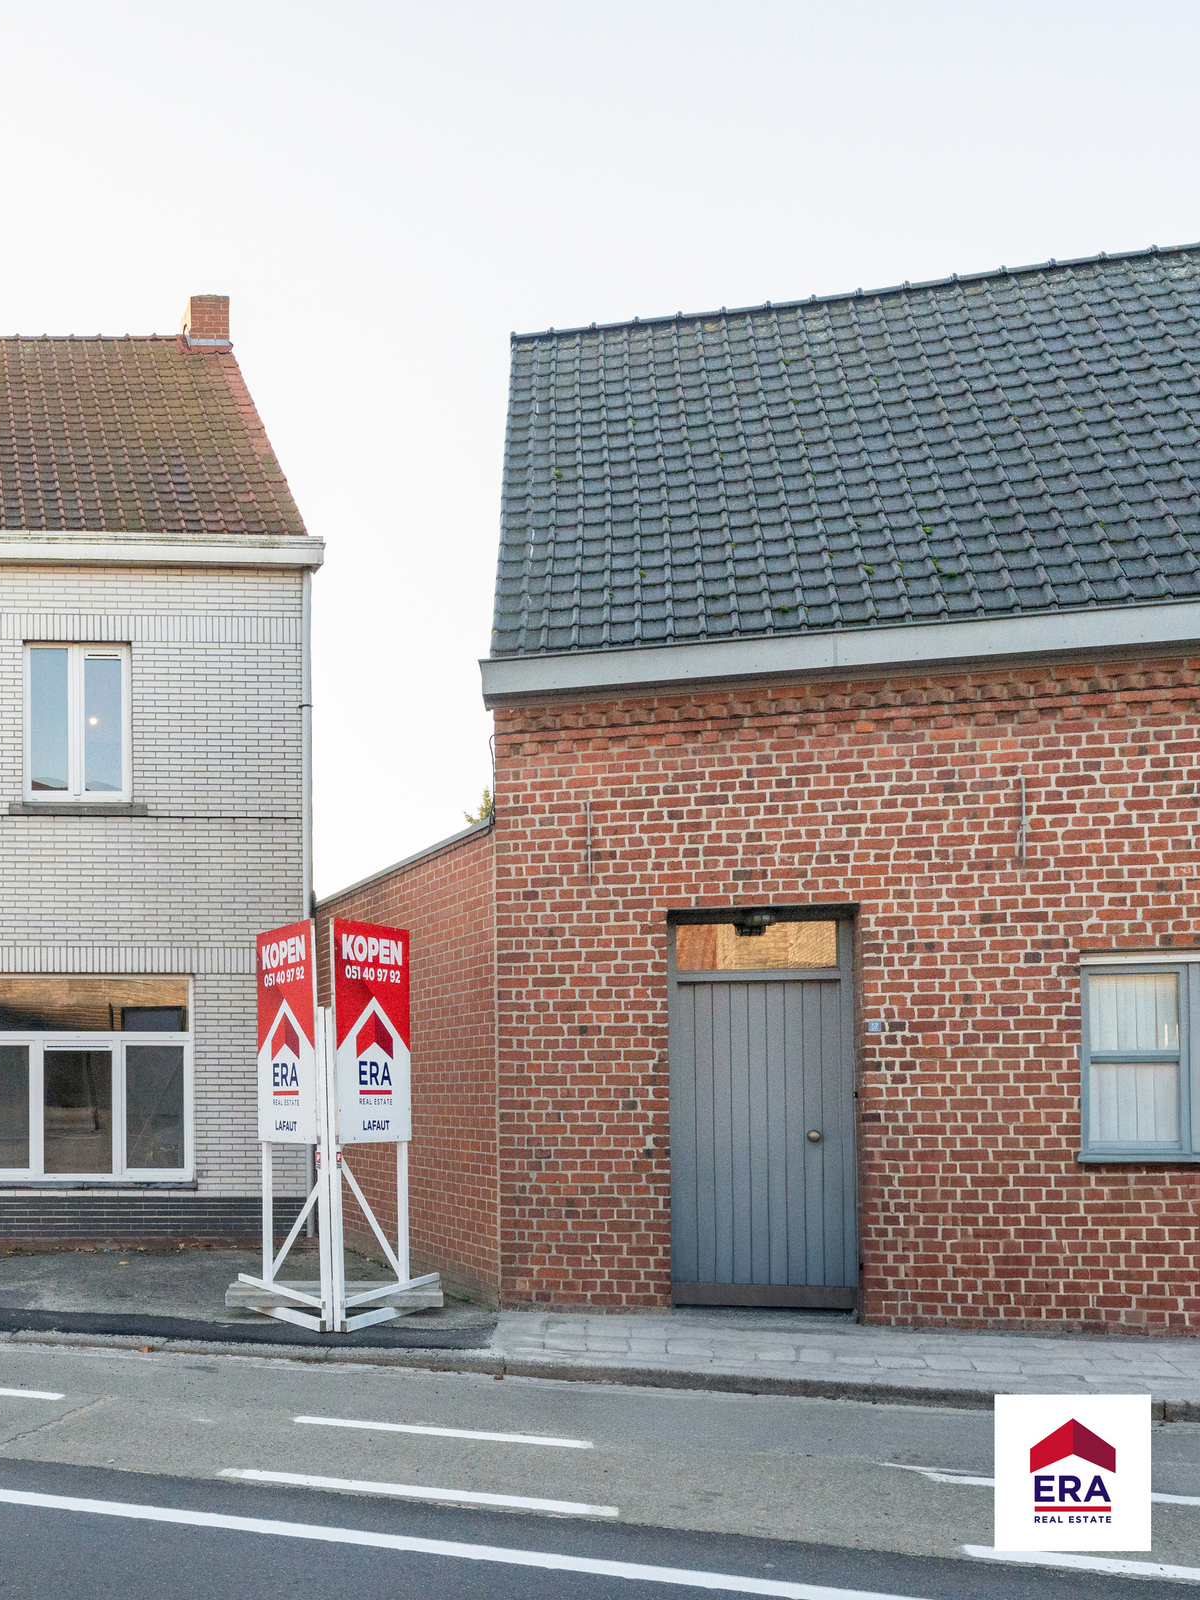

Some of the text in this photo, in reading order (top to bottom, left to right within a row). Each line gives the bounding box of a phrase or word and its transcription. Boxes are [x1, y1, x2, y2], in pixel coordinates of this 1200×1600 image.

[262, 934, 306, 970] KOPEN
[342, 933, 403, 966] KOPEN
[264, 966, 304, 987] 051 40 97 92
[345, 965, 401, 983] 051 40 97 92
[273, 1062, 299, 1087] ERA
[359, 1060, 392, 1086] ERA
[284, 1099, 300, 1107] ESTATE
[374, 1098, 393, 1106] ESTATE
[275, 1120, 297, 1132] LAFAUT
[362, 1120, 390, 1131] LAFAUT
